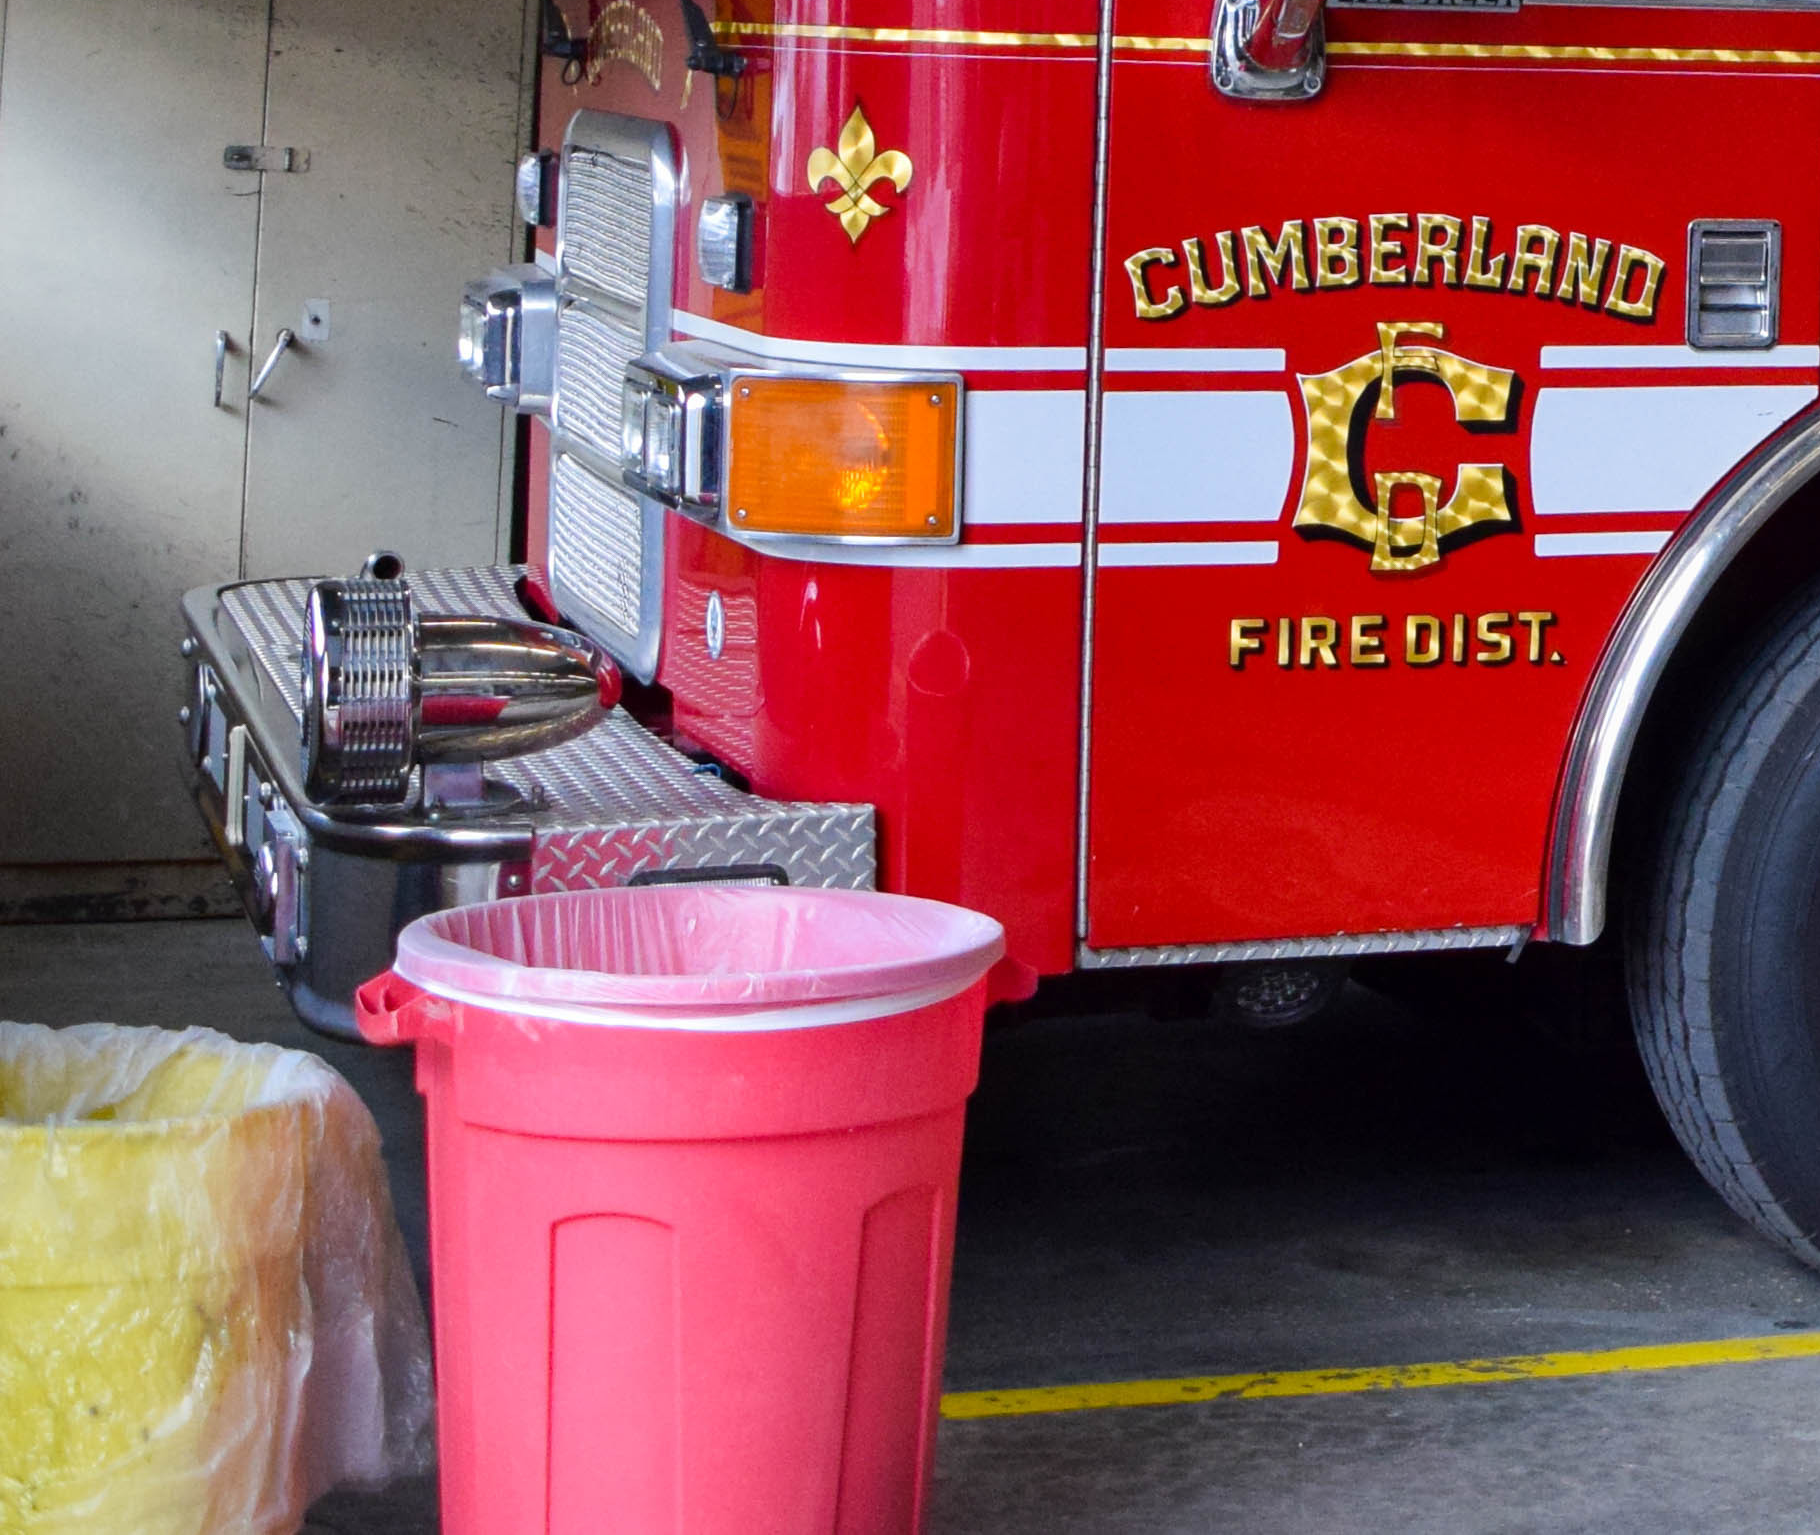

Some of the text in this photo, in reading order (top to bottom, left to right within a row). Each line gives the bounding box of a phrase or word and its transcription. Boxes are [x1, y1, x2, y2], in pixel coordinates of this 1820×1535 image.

[1124, 213, 1666, 320] CUMBERLAND
[1230, 611, 1567, 669] FIRE DIST.
